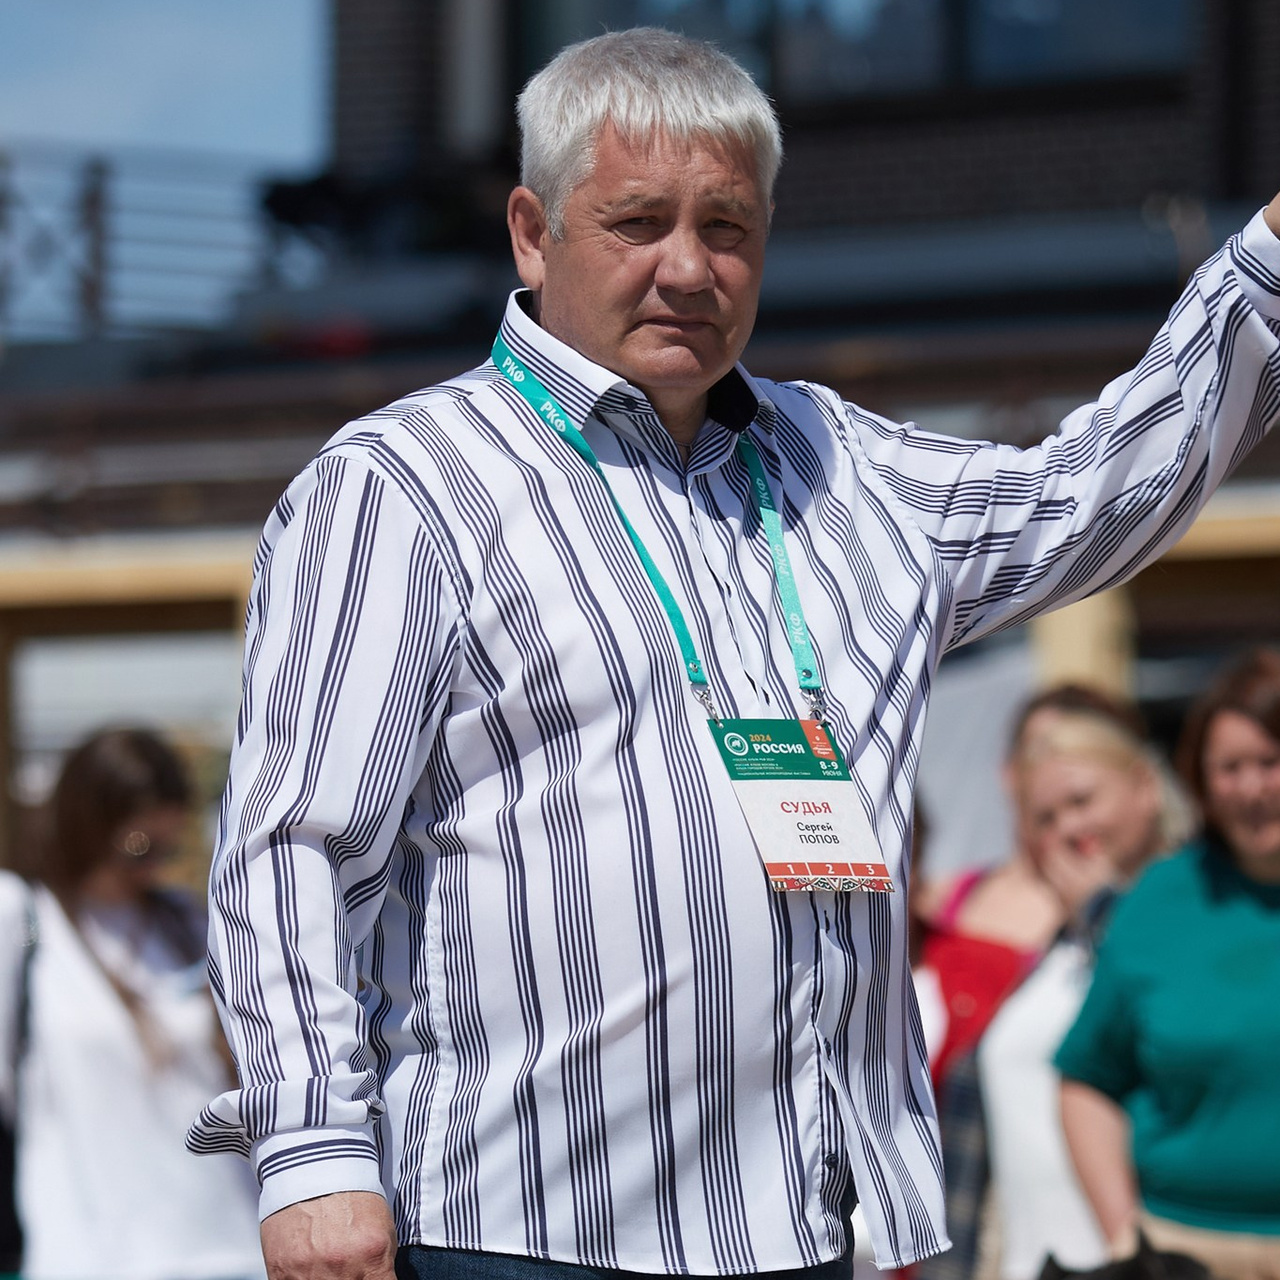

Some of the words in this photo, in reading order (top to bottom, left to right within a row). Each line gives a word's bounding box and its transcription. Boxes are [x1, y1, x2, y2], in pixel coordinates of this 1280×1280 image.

[502, 355, 526, 383] РКФ
[540, 400, 567, 433] РКФ
[755, 477, 773, 509] РКФ
[774, 543, 790, 575] РКФ
[788, 612, 806, 646] РКФ
[749, 734, 772, 742] 2024
[752, 743, 806, 754] РОССИЯ
[819, 761, 839, 770] 8-9
[780, 801, 833, 816] СУДЬЯ
[796, 821, 833, 833] Сергей
[799, 834, 840, 845] ПОПОВ
[786, 864, 795, 875] 1
[825, 864, 835, 874] 2
[867, 864, 875, 875] 3
